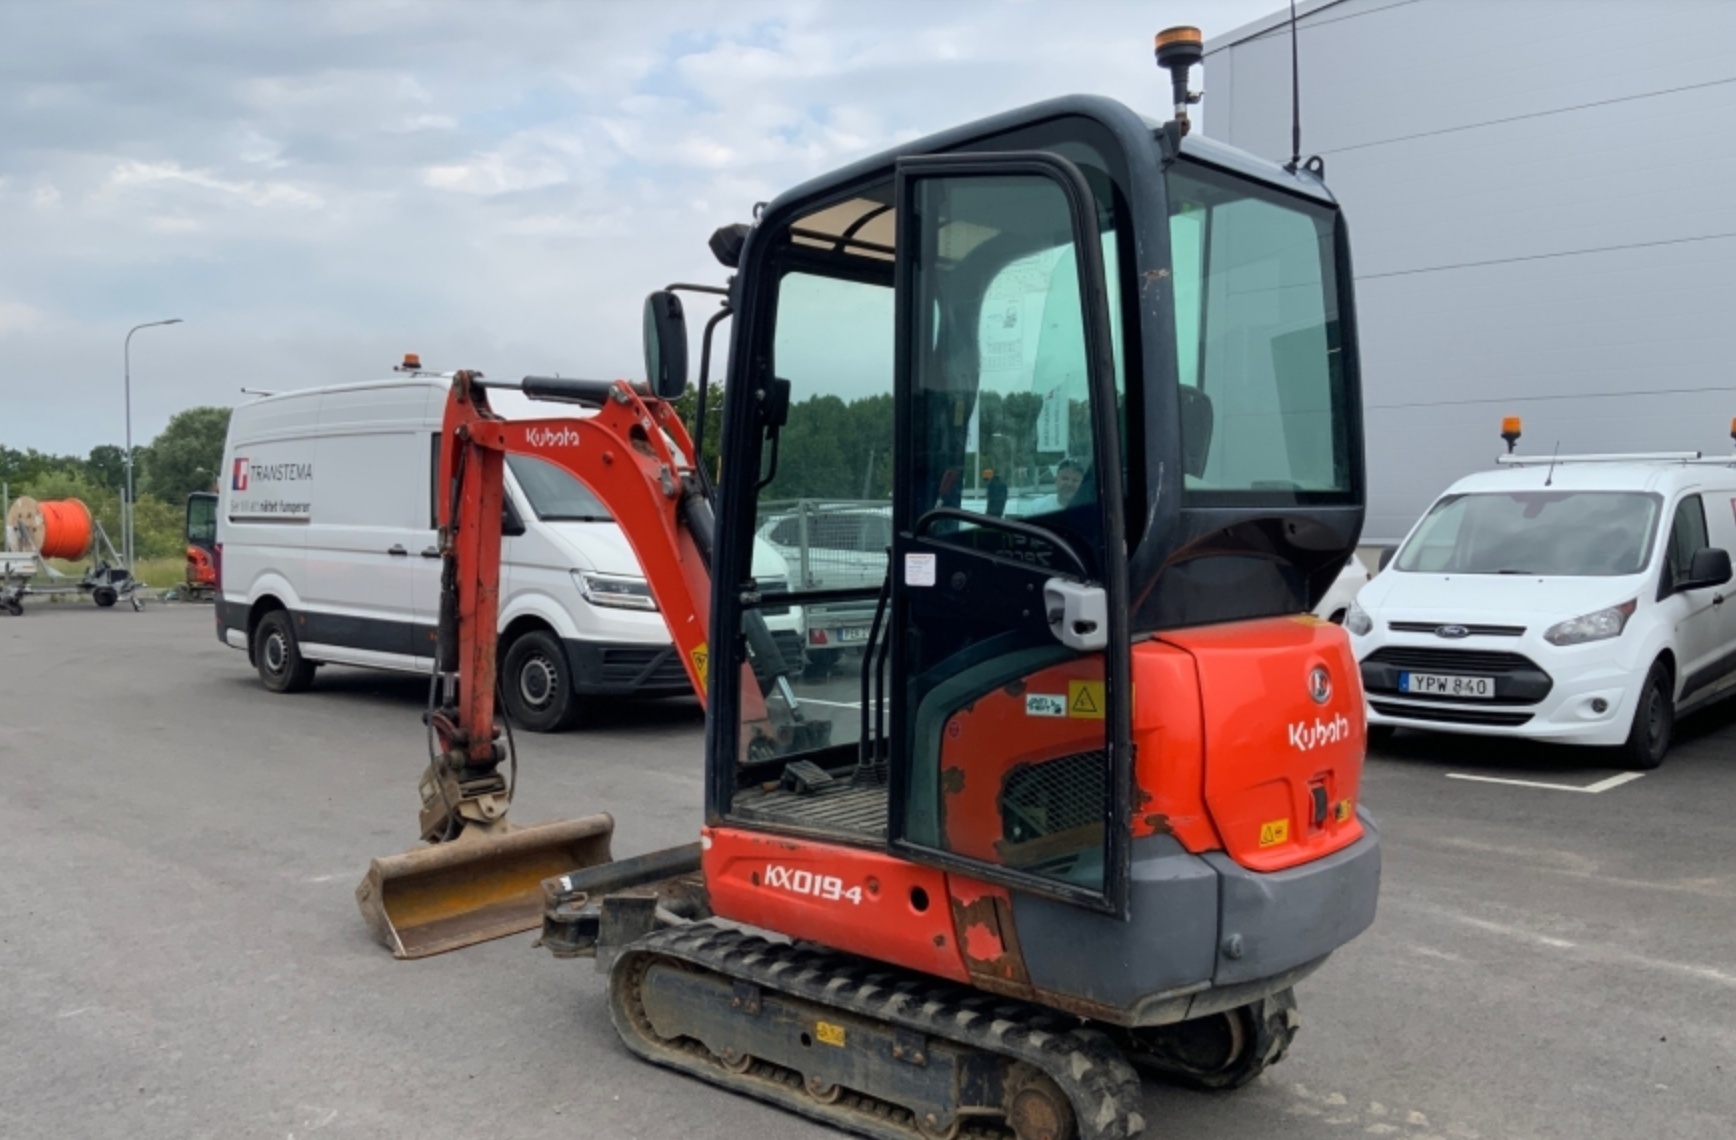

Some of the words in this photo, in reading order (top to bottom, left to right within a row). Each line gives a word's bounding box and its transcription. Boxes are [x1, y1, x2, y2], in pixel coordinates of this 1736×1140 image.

[525, 425, 580, 447] Kubota
[250, 462, 313, 481] TRANSTEMA
[1414, 675, 1448, 693] YPW
[1452, 677, 1487, 695] 840
[1288, 712, 1349, 751] Kubota
